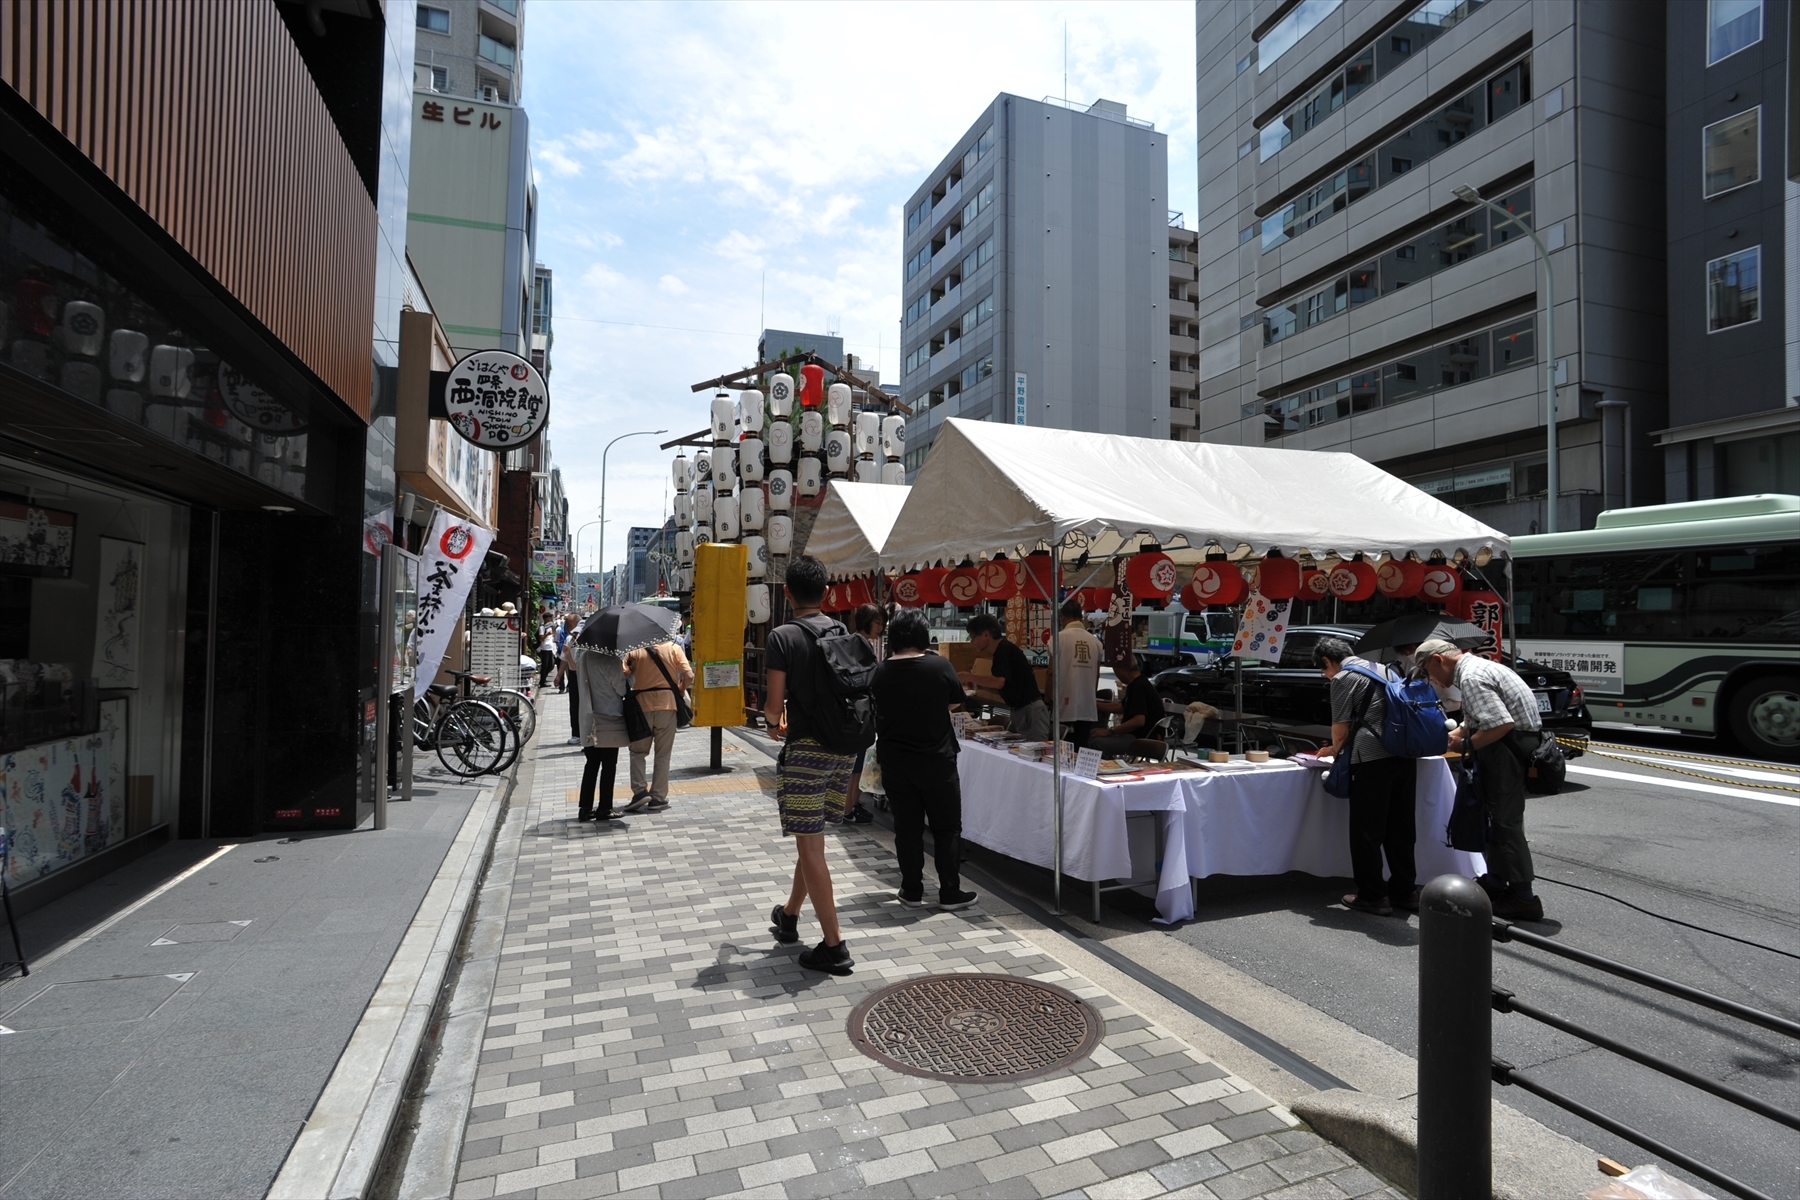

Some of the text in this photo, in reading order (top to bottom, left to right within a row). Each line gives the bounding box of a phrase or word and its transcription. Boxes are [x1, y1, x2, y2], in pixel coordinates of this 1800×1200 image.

[422, 101, 501, 130] 生ビル
[467, 359, 510, 375] ごはんや
[477, 375, 503, 390] 四条
[450, 378, 543, 420] 西洞院食堂
[478, 409, 518, 418] NISHINO
[481, 421, 512, 431] SHOKU
[488, 430, 509, 442] DO
[1624, 711, 1693, 723] 京都市交通局
